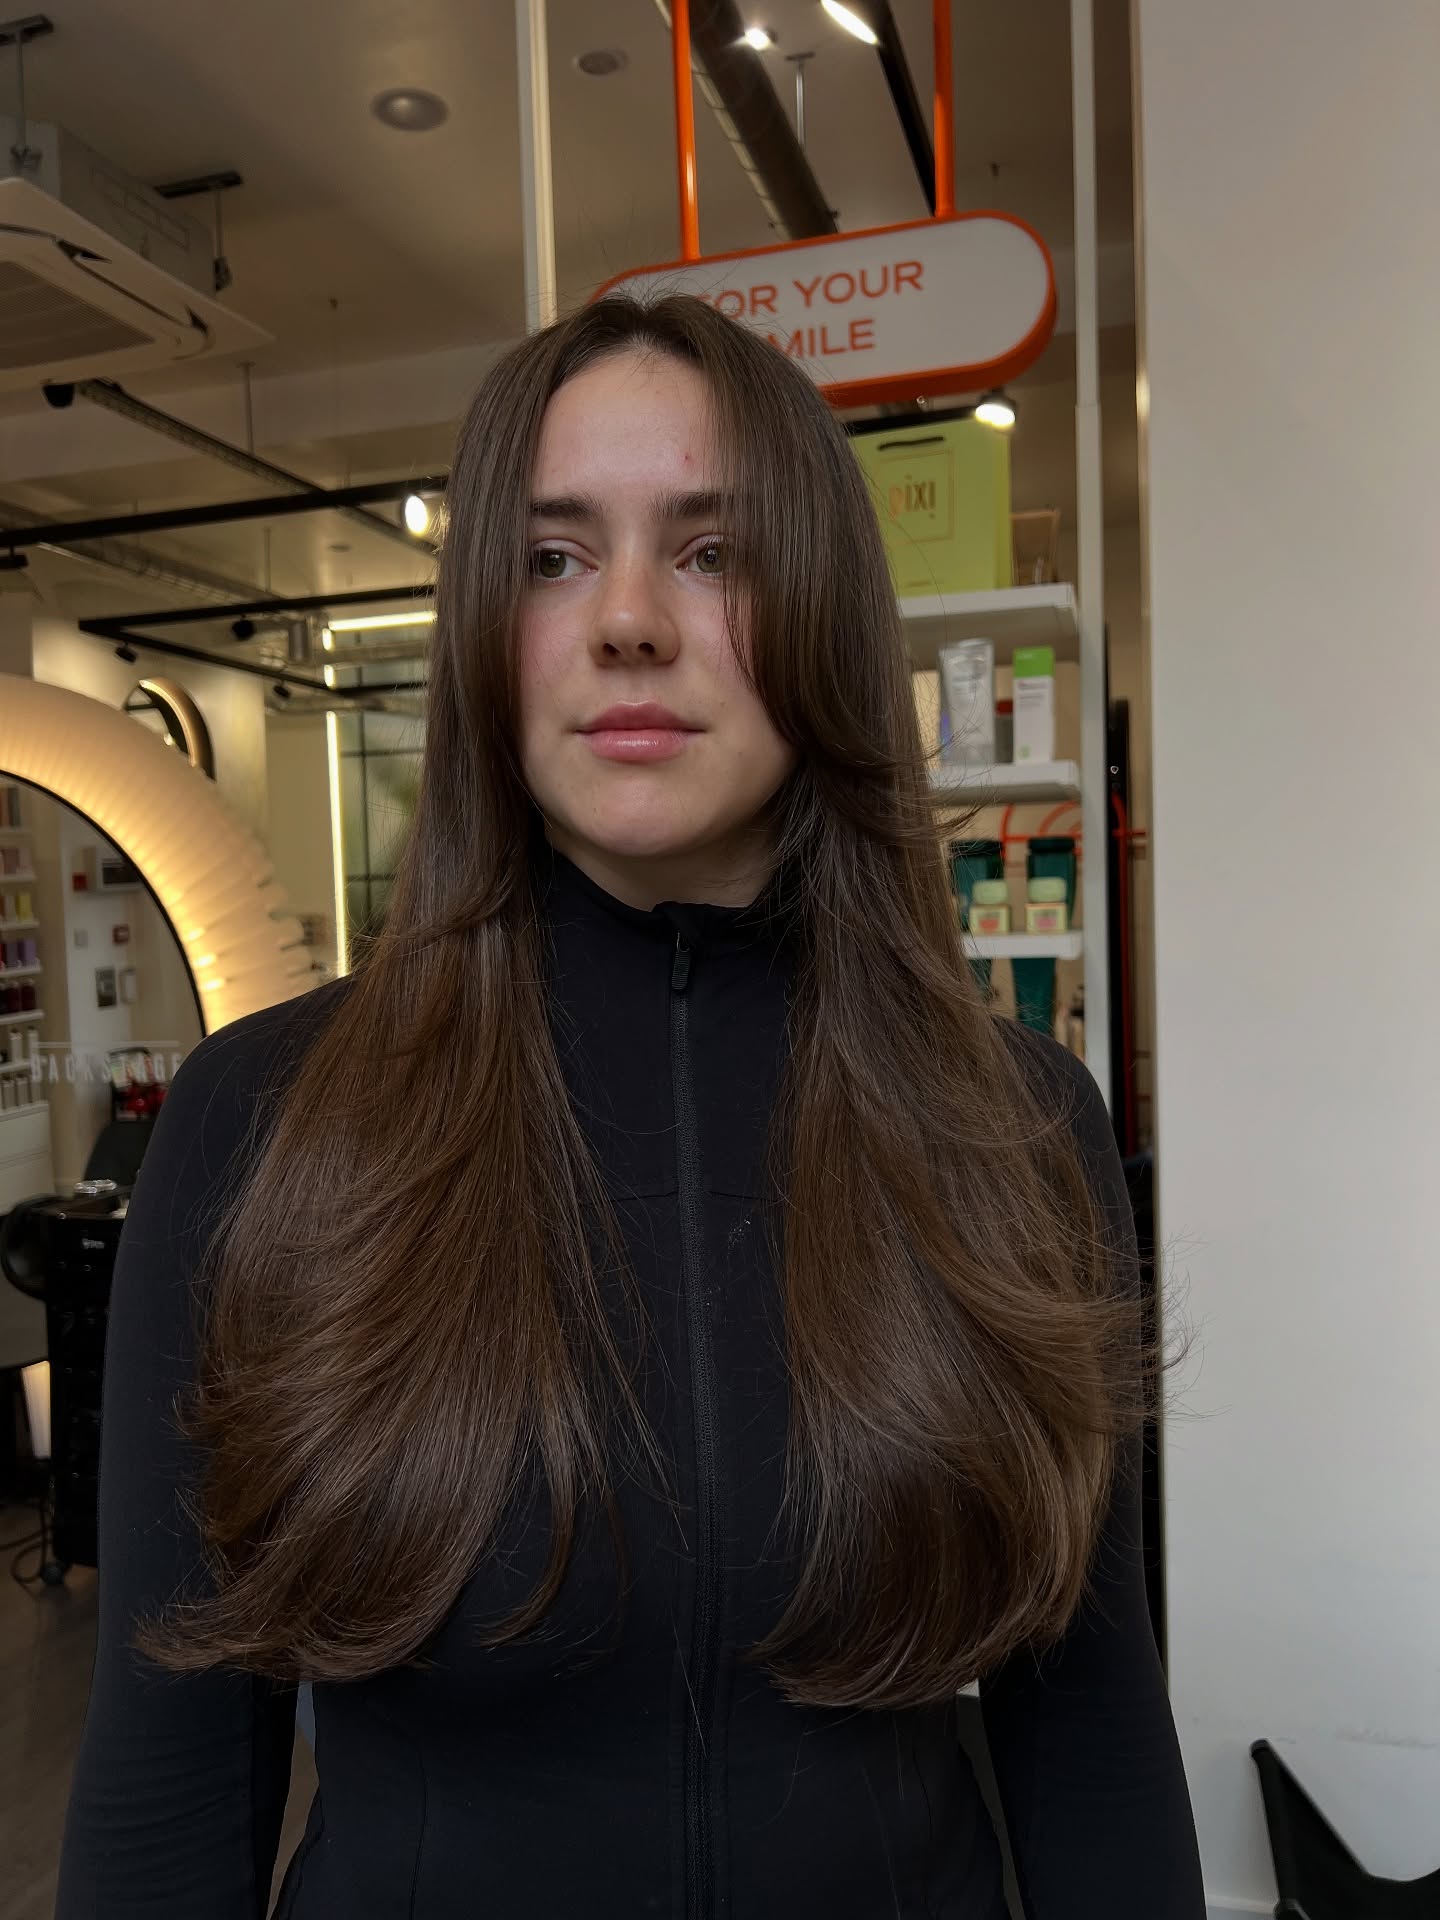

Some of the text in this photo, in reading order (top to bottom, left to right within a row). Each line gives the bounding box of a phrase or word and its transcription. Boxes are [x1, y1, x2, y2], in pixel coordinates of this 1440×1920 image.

[697, 260, 924, 320] OR YOUR
[768, 319, 875, 358] MILE
